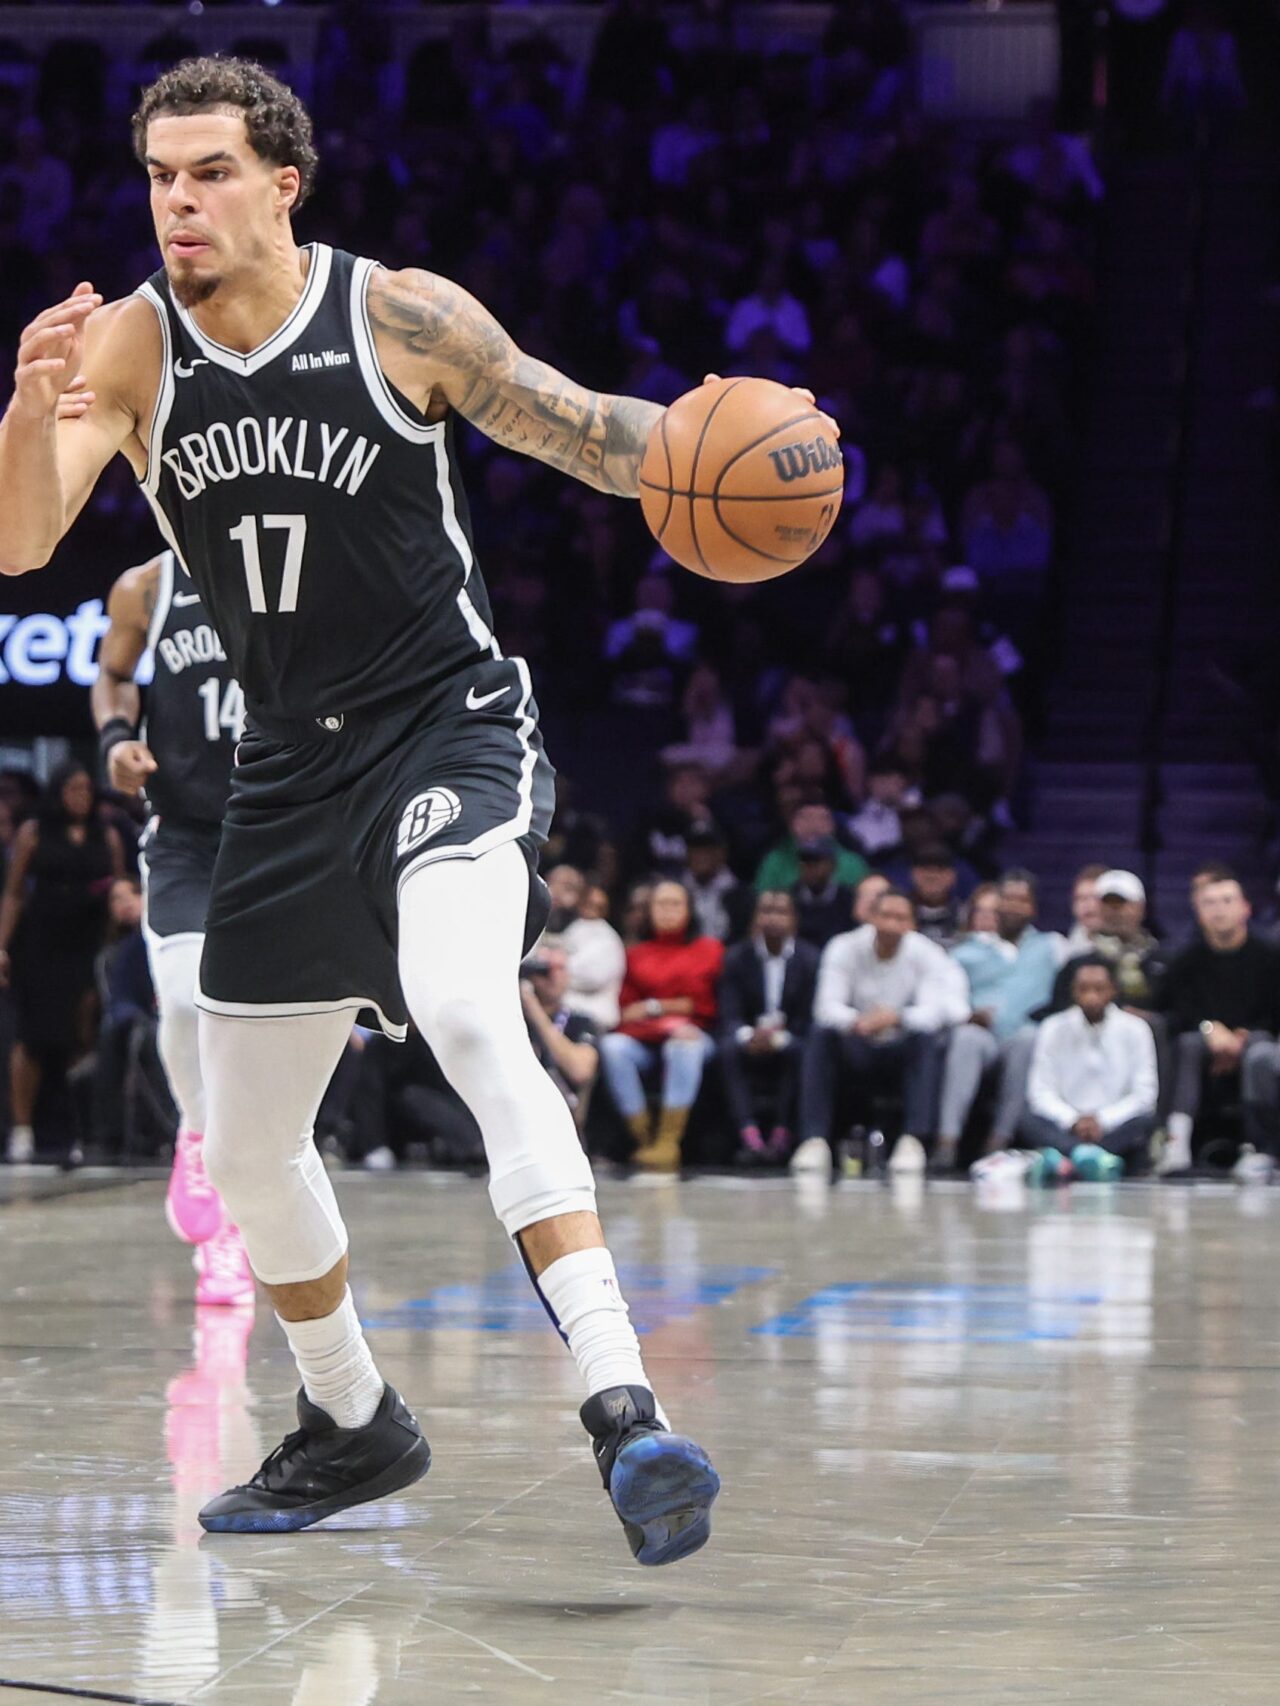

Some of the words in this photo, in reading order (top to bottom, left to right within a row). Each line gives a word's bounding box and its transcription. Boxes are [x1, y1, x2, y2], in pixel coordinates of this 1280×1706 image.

[291, 354, 308, 371] All
[309, 353, 322, 369] In
[321, 350, 350, 367] Won
[161, 416, 382, 500] BROOKLYN
[228, 514, 307, 613] 17
[198, 677, 248, 742] 14
